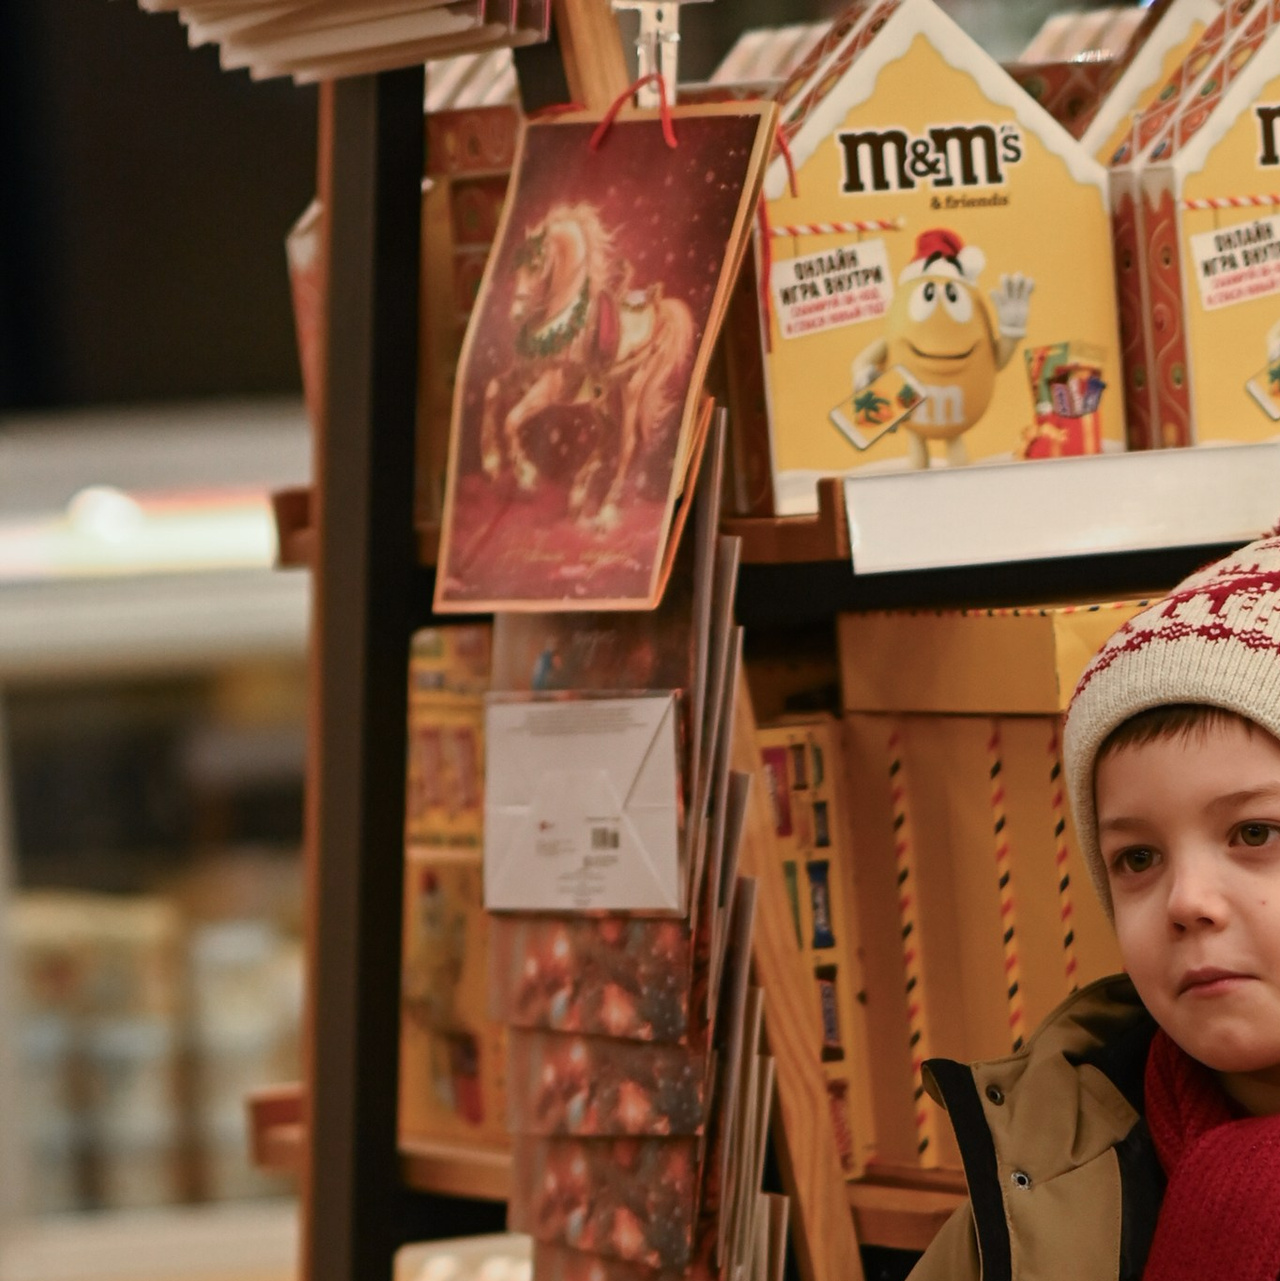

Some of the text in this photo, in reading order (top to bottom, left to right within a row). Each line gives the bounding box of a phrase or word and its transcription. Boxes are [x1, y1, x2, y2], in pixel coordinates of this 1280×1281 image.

[945, 194, 1008, 208] friends
[794, 249, 857, 280] ОНЛАЙН
[1202, 254, 1238, 277] ИГРА
[781, 281, 820, 305] ИГРА
[824, 265, 882, 295] ВНУТРИ
